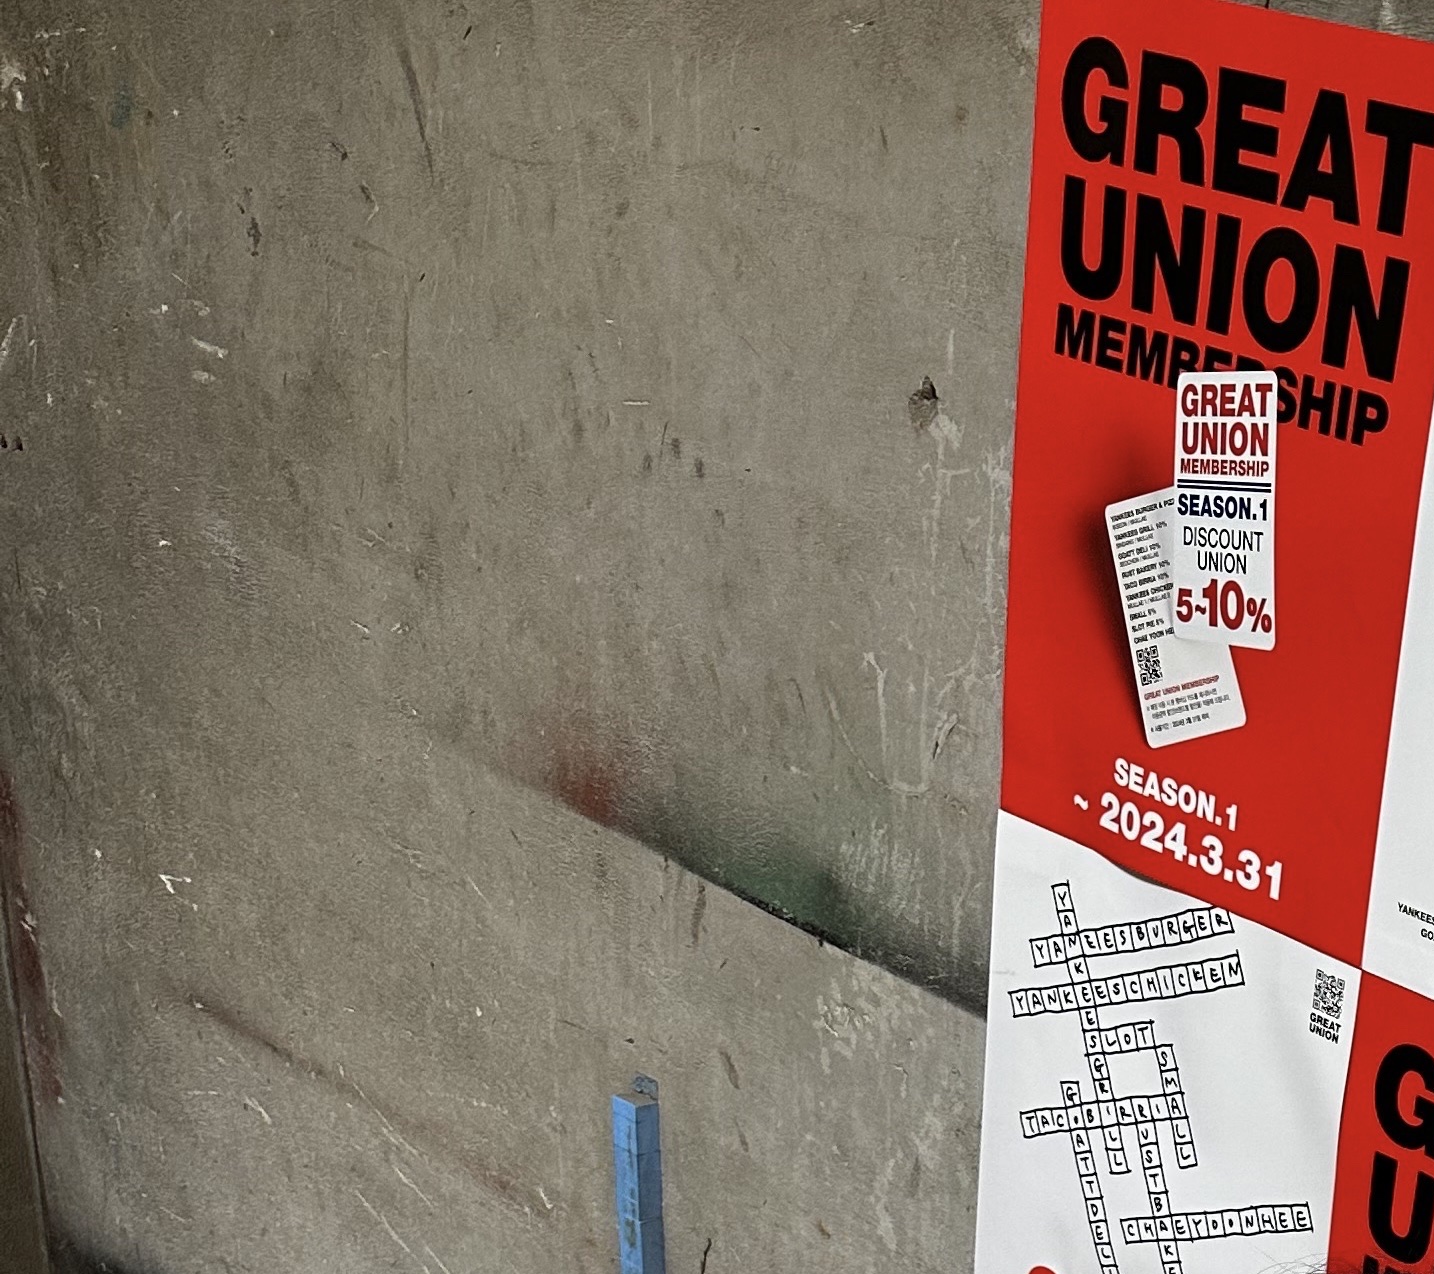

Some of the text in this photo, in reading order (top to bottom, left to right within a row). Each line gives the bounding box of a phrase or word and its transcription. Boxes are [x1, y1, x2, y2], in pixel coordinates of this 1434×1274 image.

[1061, 174, 1411, 383] UNION
[1181, 383, 1273, 418] GREAT
[1182, 421, 1270, 457] UNION
[1180, 457, 1270, 478] MEMBERSHIP
[1176, 494, 1269, 522] SEASON.1
[1183, 526, 1264, 552] DISCOUNT
[1197, 550, 1248, 575] UNION
[1113, 757, 1239, 832] SEASON.1
[1099, 791, 1283, 901] 2024.3.31
[1309, 1022, 1339, 1044] UNION
[1310, 1012, 1341, 1033] GREAT
